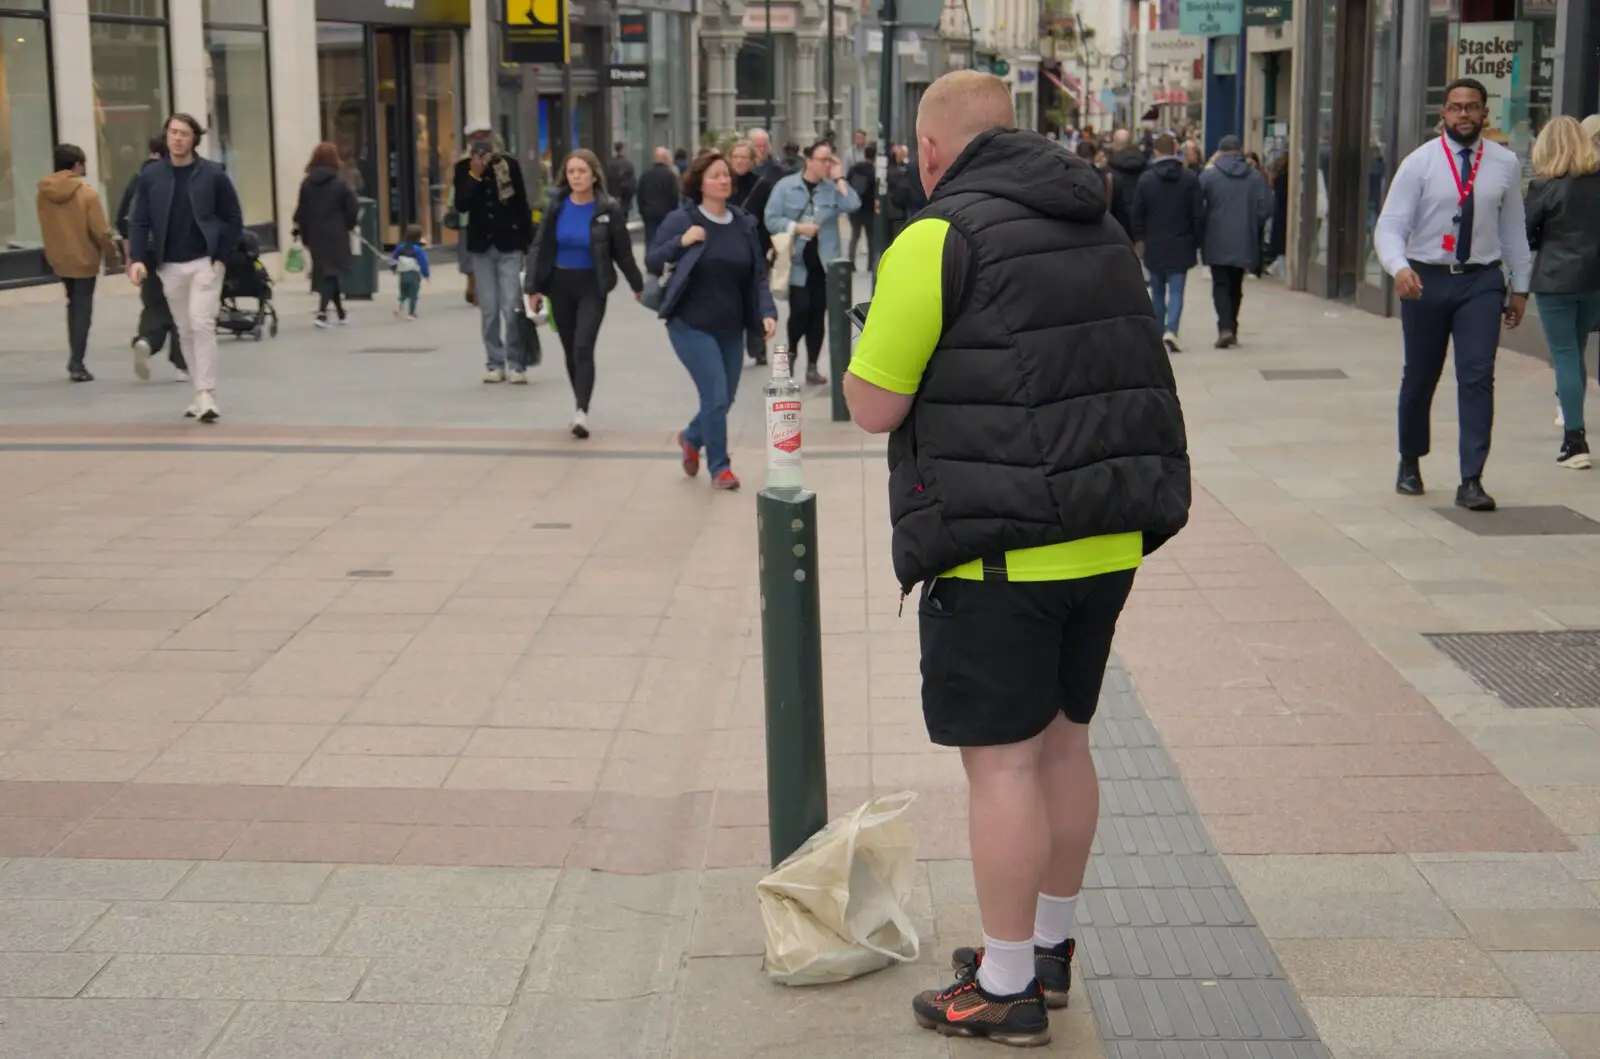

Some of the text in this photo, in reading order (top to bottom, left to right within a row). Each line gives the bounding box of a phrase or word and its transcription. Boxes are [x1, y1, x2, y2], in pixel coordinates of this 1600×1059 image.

[1460, 36, 1523, 55] Stacker
[774, 402, 800, 411] SMIRNO
[783, 413, 797, 421] ICE
